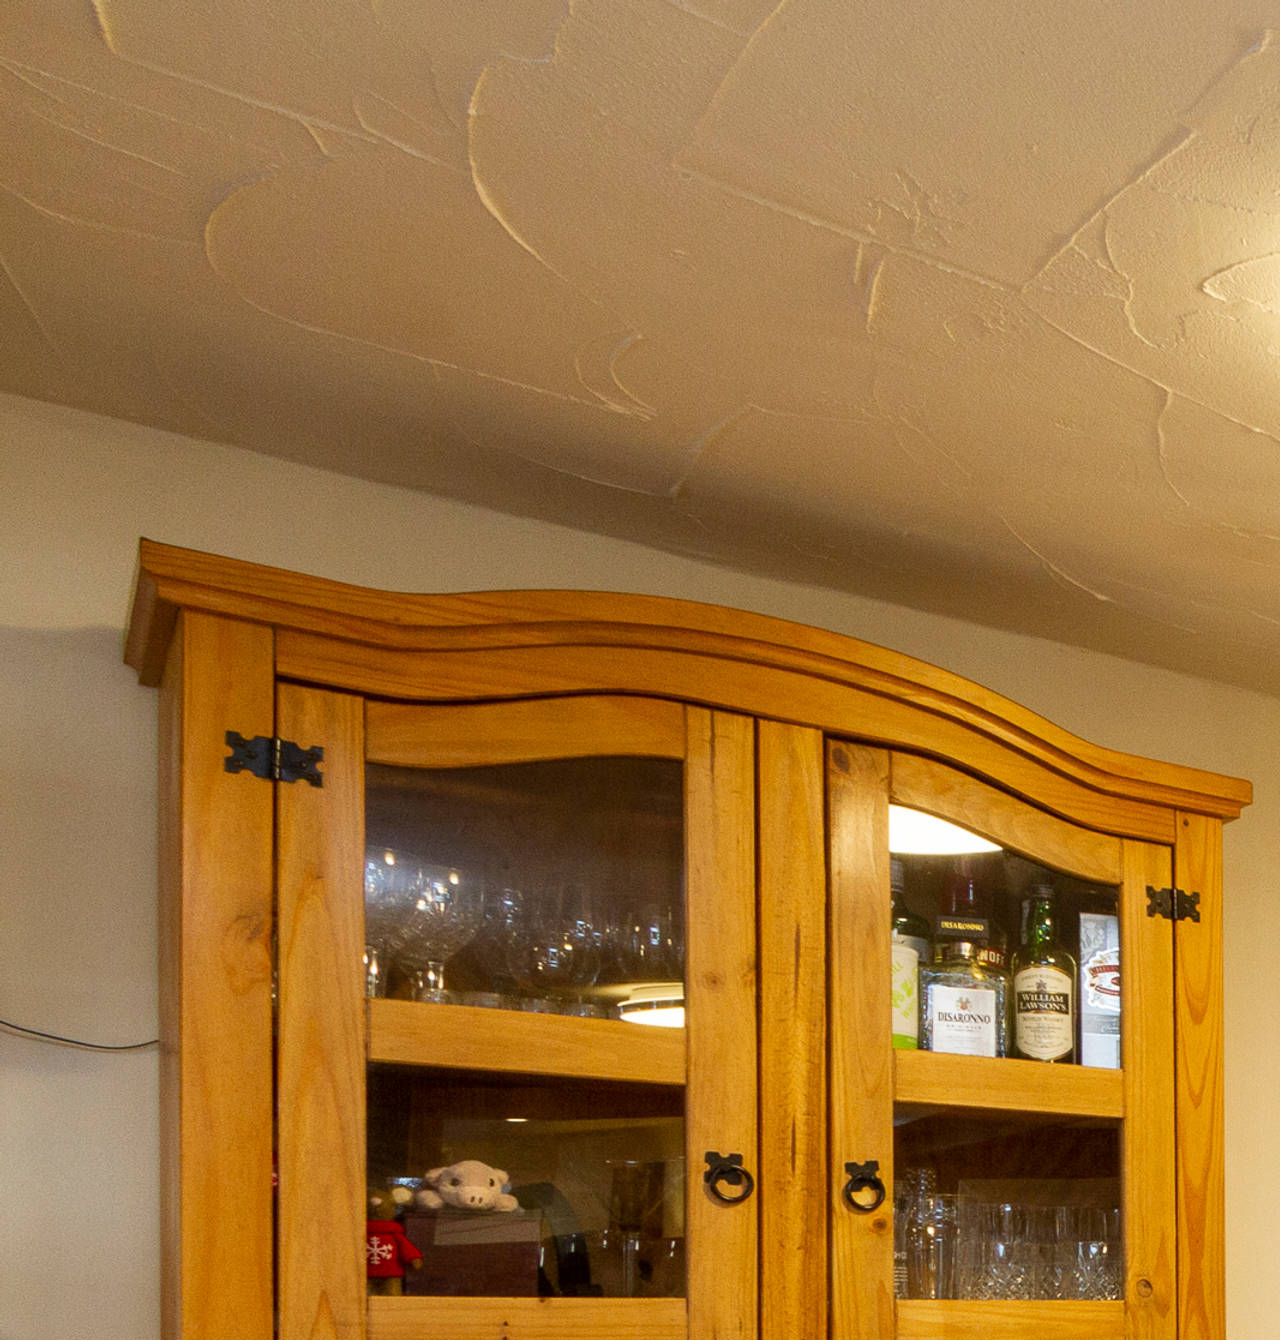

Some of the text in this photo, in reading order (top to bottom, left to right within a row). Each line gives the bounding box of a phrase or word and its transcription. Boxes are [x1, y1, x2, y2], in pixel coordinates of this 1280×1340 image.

[1022, 993, 1064, 1003] WILLIAM
[1019, 1002, 1067, 1011] LAWSON'S
[938, 1011, 991, 1025] DISARONNO
